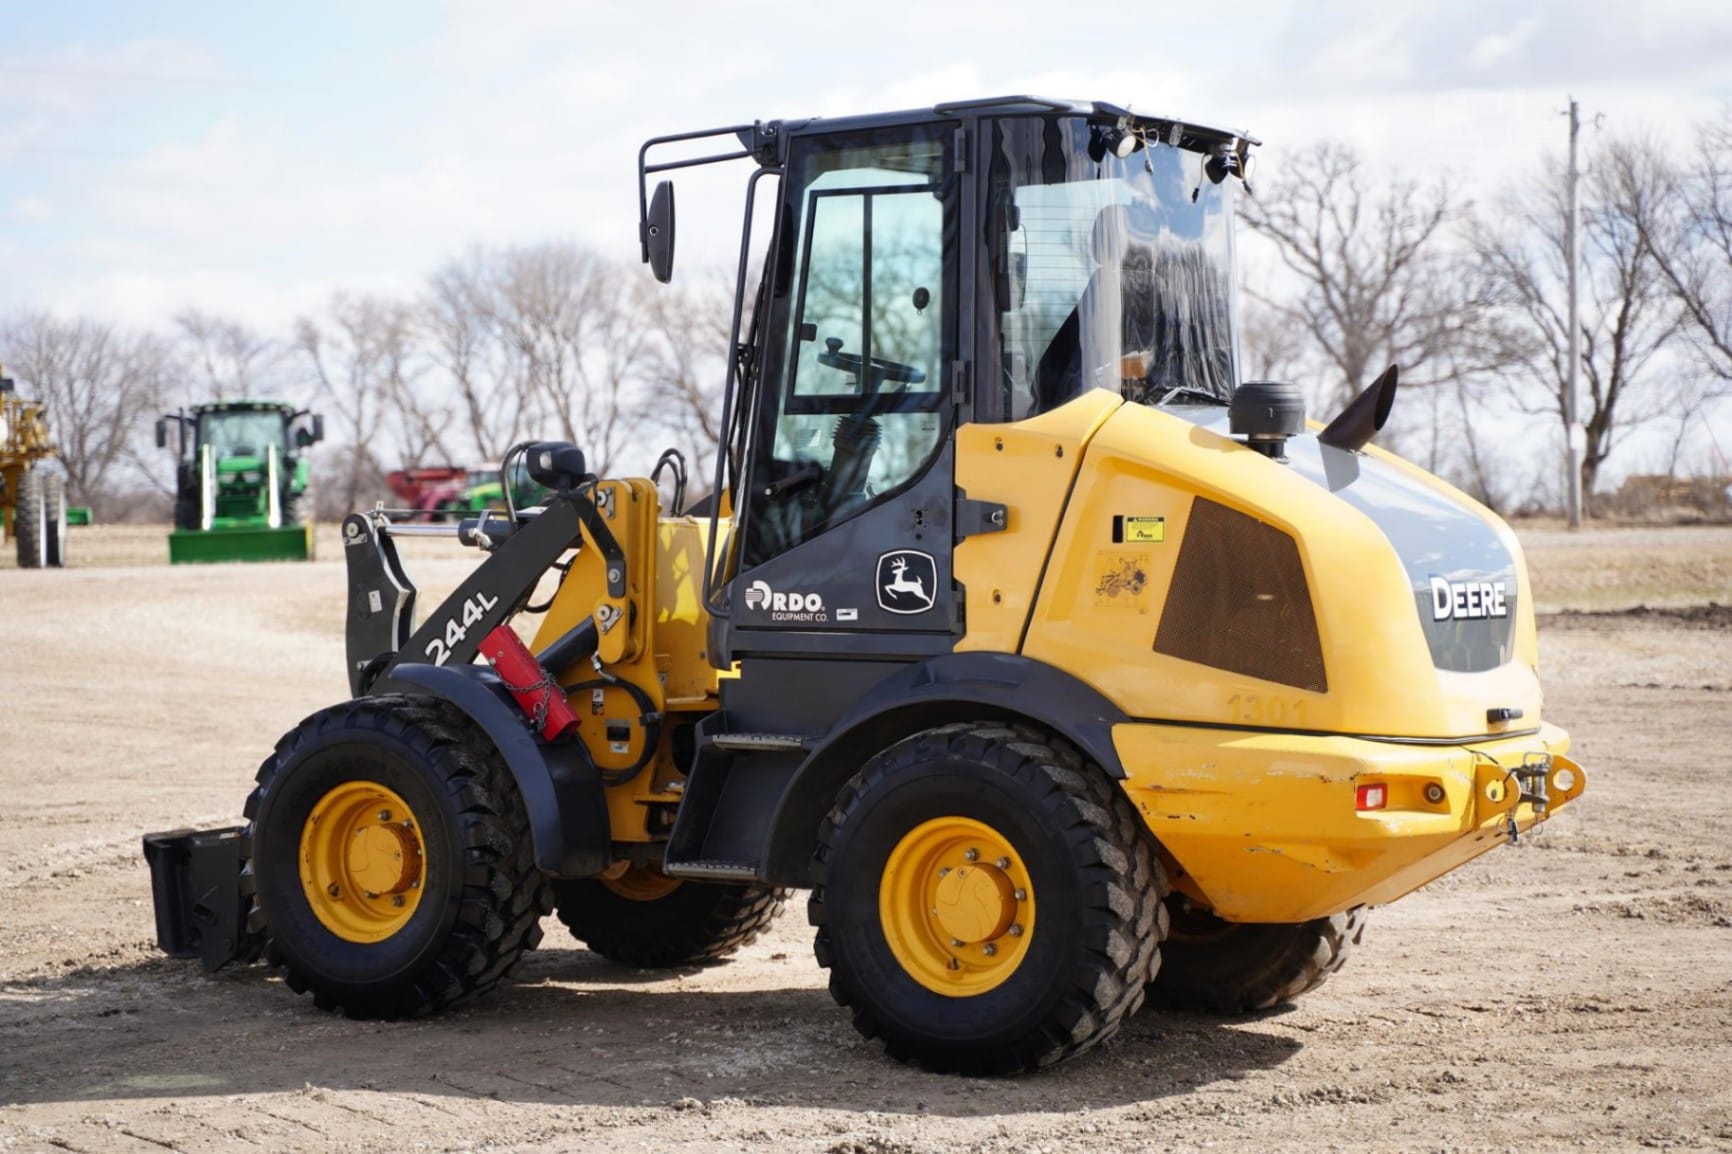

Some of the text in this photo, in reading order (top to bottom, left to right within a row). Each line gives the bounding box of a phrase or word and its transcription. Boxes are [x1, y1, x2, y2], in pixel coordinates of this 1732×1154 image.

[772, 612, 813, 621] EQUIPMENT
[815, 613, 829, 621] CO.
[1430, 576, 1507, 620] DEERE
[425, 592, 499, 667] 244L
